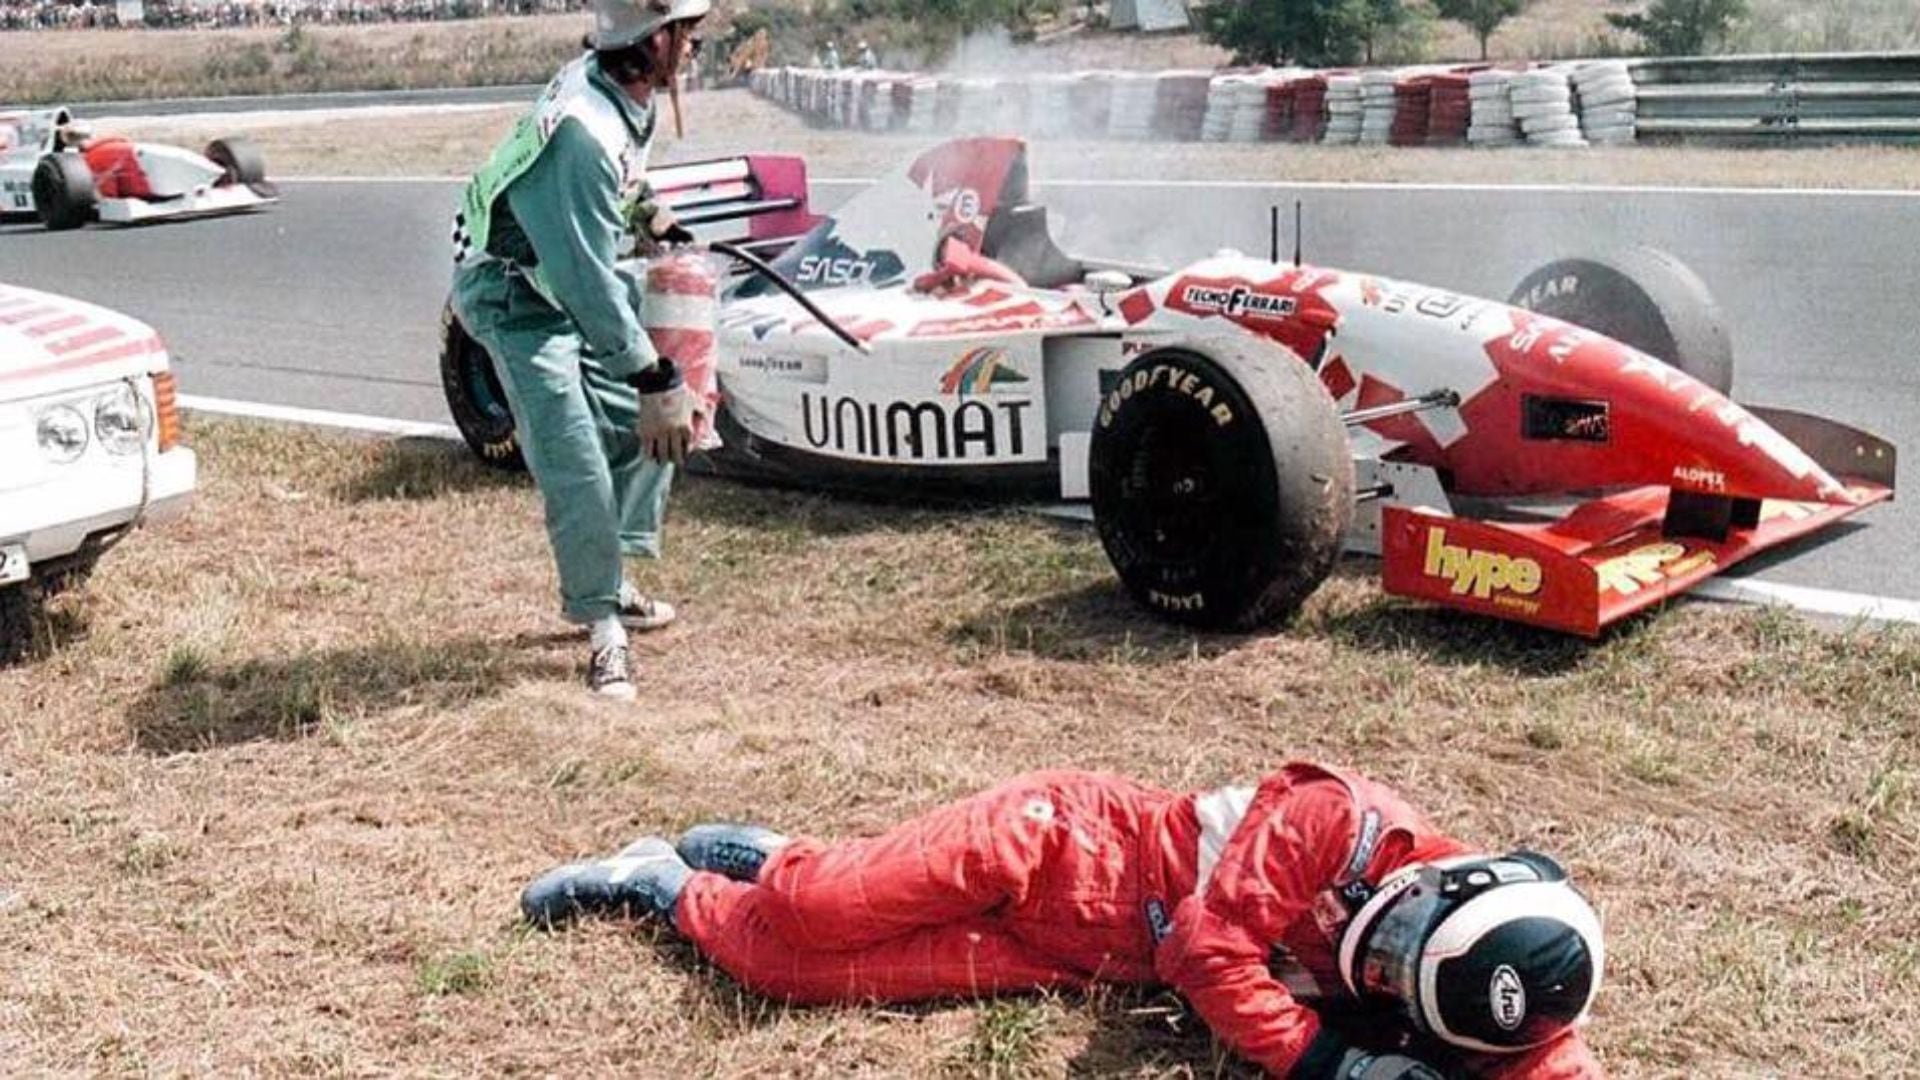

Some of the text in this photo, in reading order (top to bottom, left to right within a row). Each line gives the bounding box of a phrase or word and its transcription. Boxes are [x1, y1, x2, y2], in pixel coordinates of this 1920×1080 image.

[801, 393, 1032, 458] UNIMAT
[1100, 363, 1233, 428] GOODYEAR
[1424, 525, 1543, 598] hype
[1493, 969, 1520, 1021] Arai
